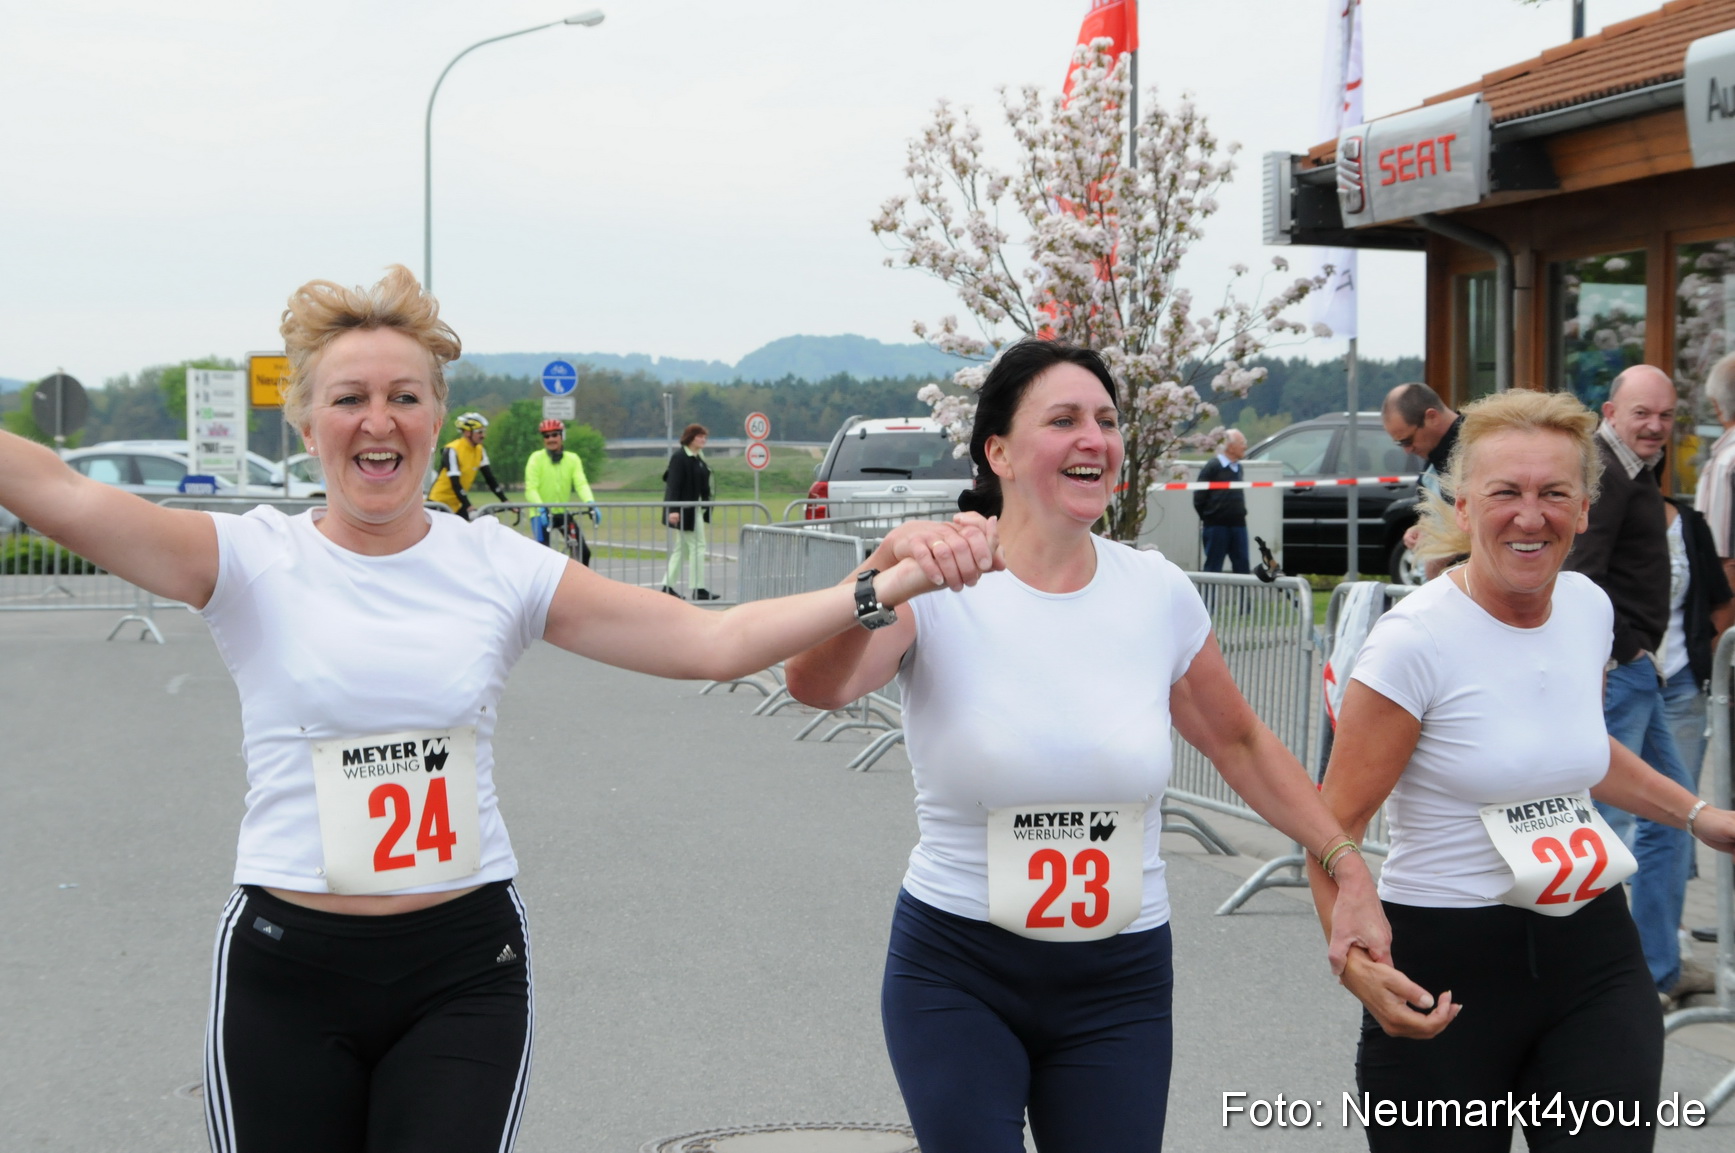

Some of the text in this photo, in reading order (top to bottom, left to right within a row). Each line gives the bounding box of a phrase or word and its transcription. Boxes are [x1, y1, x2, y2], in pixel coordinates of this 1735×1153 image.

[1379, 134, 1456, 185] SEAT
[751, 421, 765, 433] 60
[342, 741, 417, 766] MEYER
[343, 759, 420, 779] WERBUNG
[1013, 812, 1084, 828] MEYER
[1506, 797, 1569, 823] MEYER
[368, 777, 457, 872] 24
[1013, 828, 1085, 840] WERBUNG
[1510, 812, 1574, 834] WERBUNG
[1532, 827, 1608, 905] 22
[1025, 848, 1110, 929] 23
